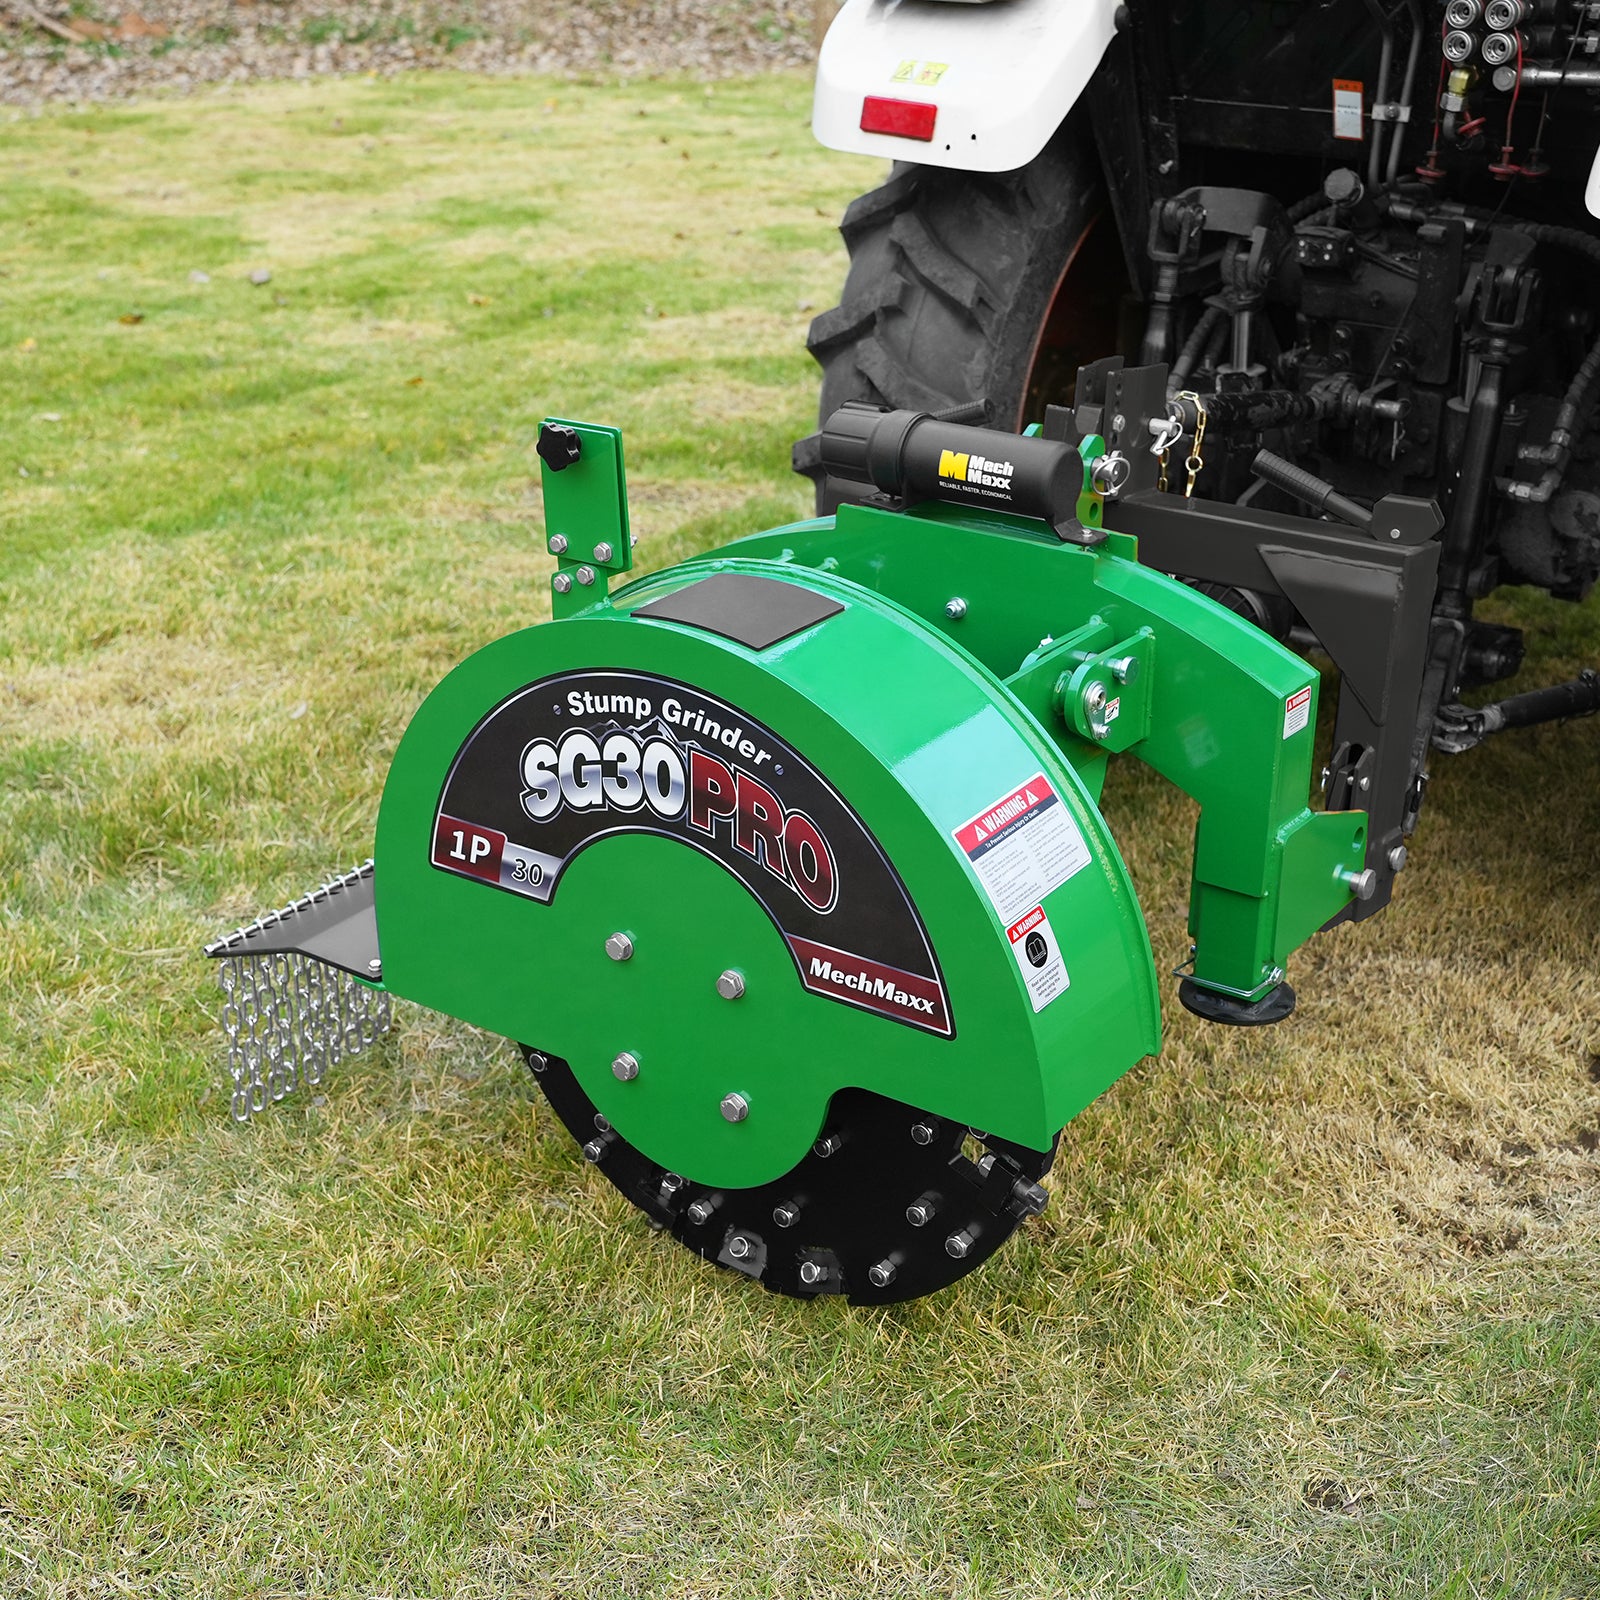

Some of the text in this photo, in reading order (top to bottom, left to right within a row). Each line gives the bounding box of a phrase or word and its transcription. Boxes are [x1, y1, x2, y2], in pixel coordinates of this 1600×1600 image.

[967, 468, 1011, 490] Maxx
[968, 455, 1014, 476] Mech
[939, 481, 1013, 500] RELIABLE, FASTER, ECONOMICAL
[566, 691, 772, 767] Stump Grinder
[981, 794, 1028, 833] WARNING
[449, 829, 492, 864] 1P
[511, 857, 544, 887] 30
[1016, 909, 1043, 935] WARNING
[808, 957, 936, 1015] MechMaxx
